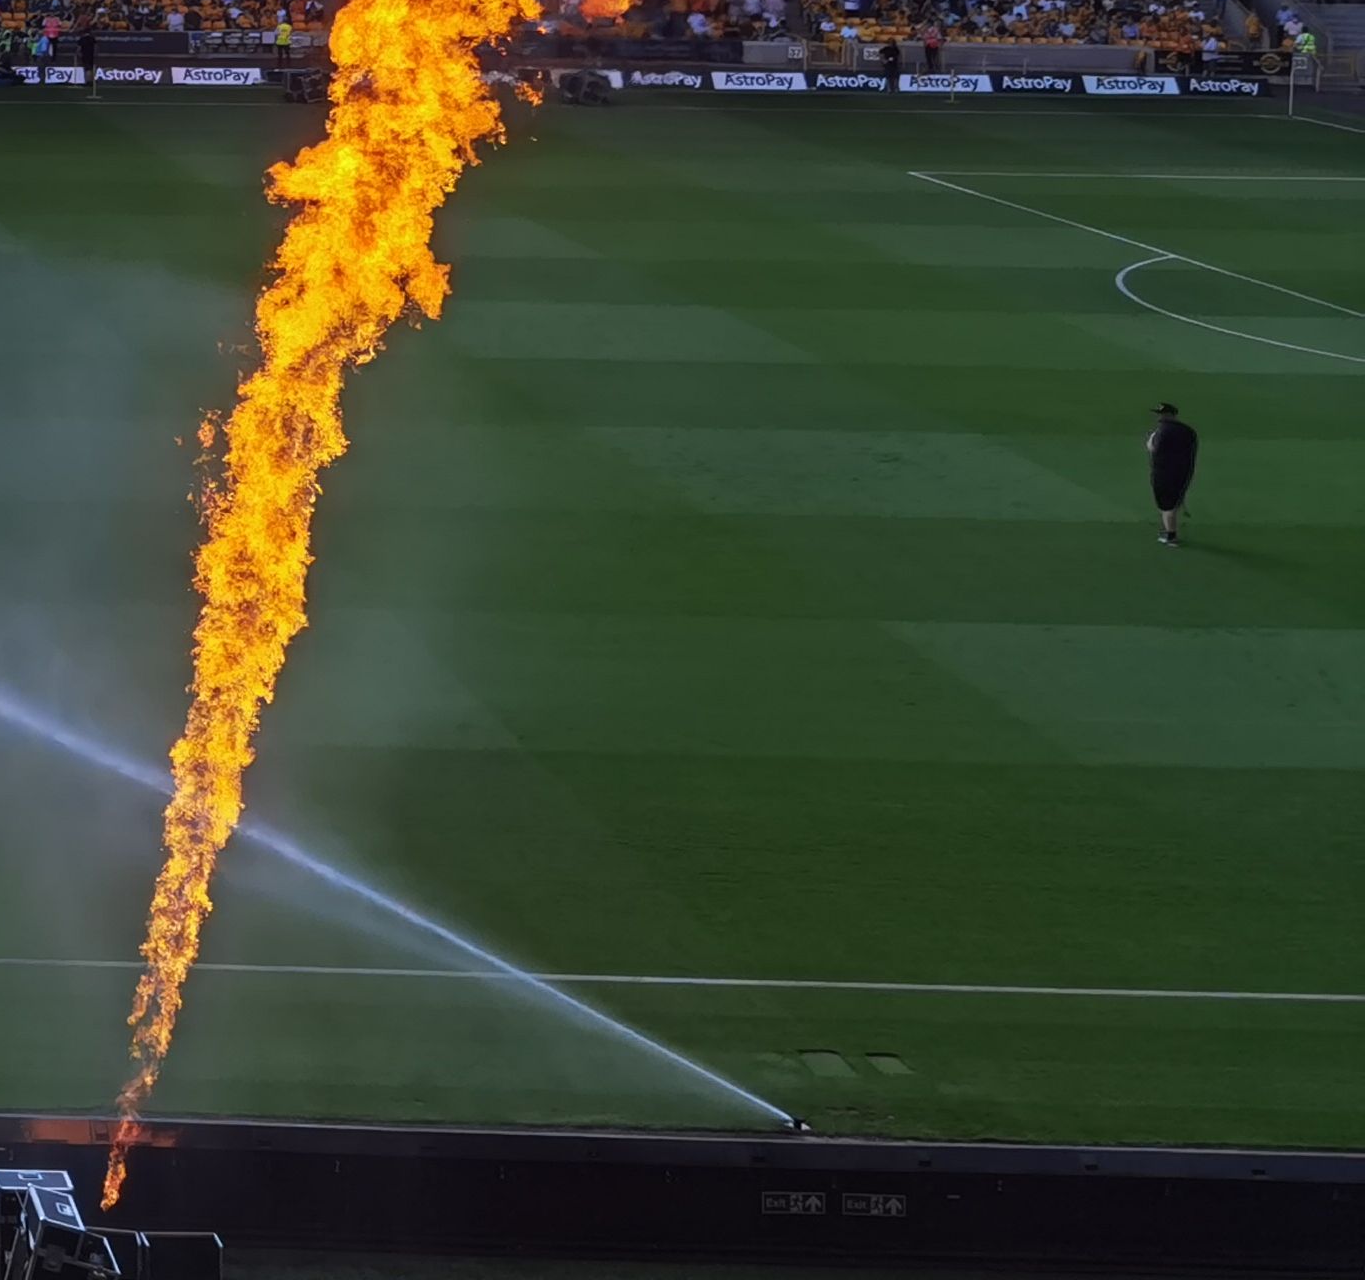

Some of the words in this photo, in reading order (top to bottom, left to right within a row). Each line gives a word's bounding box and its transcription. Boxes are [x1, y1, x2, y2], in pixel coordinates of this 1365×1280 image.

[95, 67, 163, 83] AstroPay
[183, 67, 250, 84] AstroPay
[724, 71, 794, 88] AstroPay
[816, 73, 886, 90] AstroPay
[909, 75, 980, 91] AstroPay
[1002, 75, 1072, 92] AstroPay
[1095, 76, 1166, 93] AstroPay
[1189, 78, 1259, 96] AstroPay
